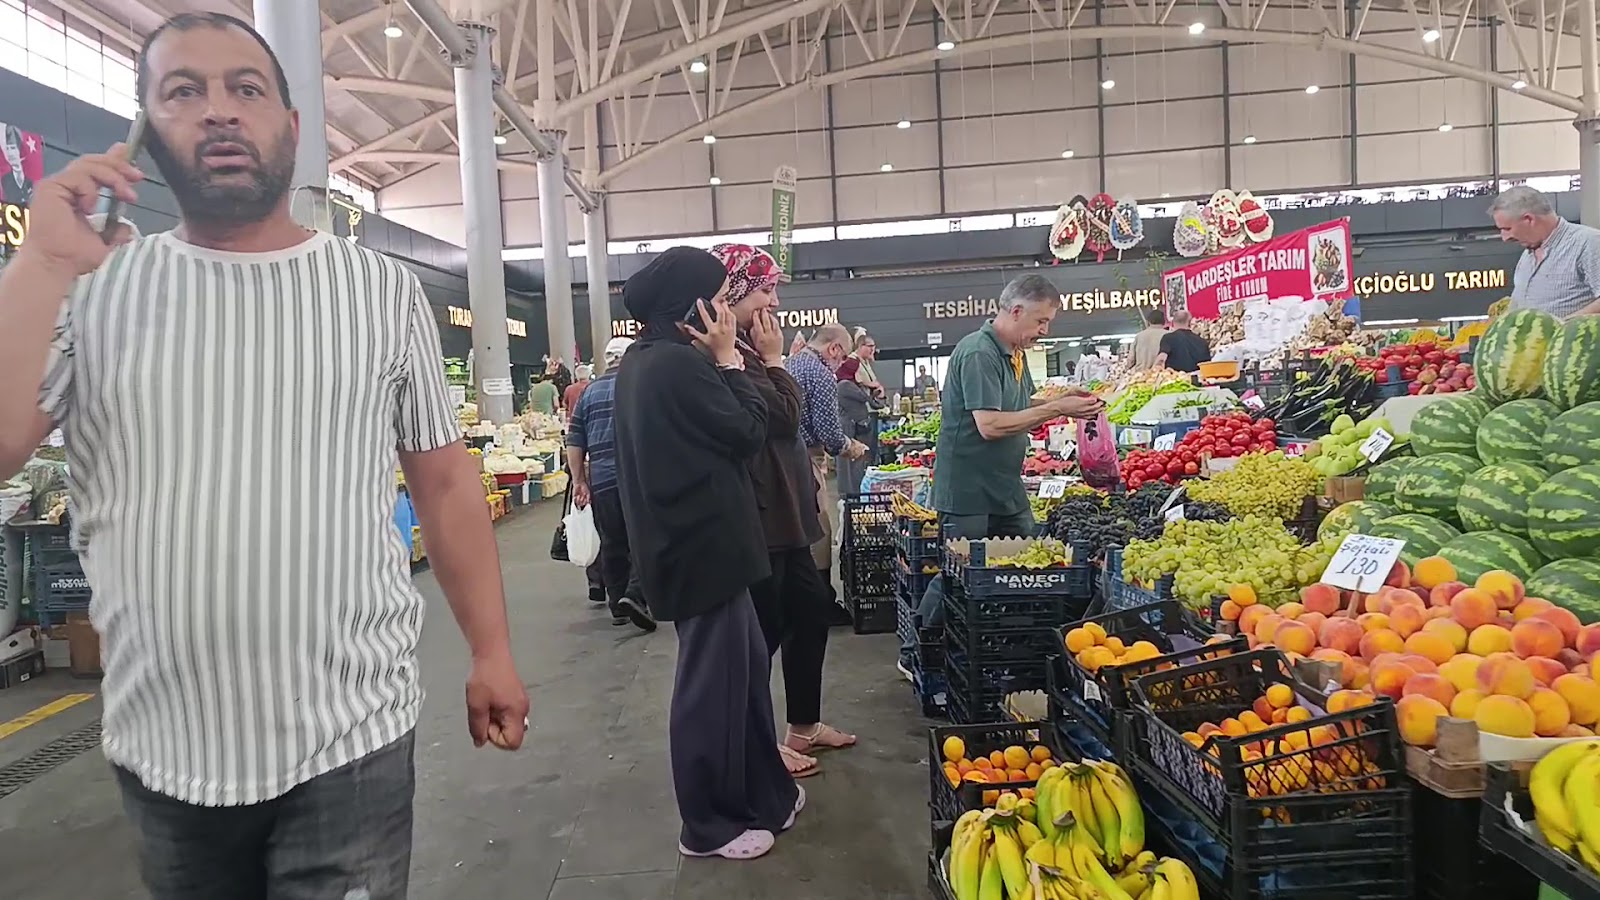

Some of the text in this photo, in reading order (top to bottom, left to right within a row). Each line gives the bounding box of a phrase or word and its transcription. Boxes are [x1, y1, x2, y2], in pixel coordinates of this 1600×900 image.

[1187, 249, 1306, 296] KARDEŞLER TARIM
[1445, 269, 1505, 290] TARIM
[1060, 288, 1165, 314] YEŞİLBAHÇ
[777, 308, 838, 327] TOHUM
[1336, 557, 1378, 575] 130
